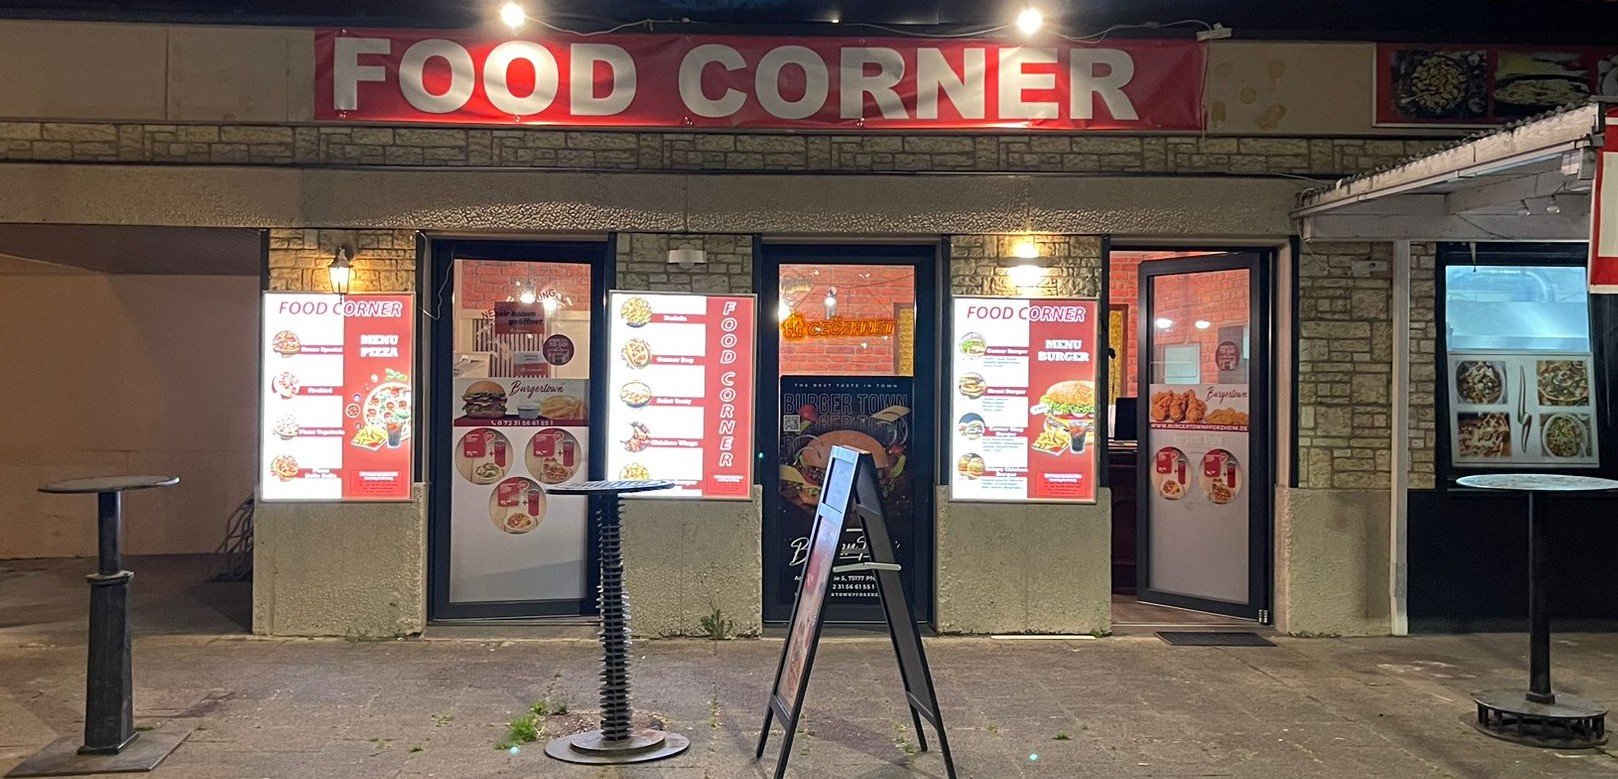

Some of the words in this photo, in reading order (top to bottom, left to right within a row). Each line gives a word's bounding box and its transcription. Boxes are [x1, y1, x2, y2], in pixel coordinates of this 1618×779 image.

[334, 37, 637, 116] FOOD
[678, 43, 1140, 121] CORNER
[279, 301, 328, 315] FOOD
[333, 301, 403, 317] CORNER
[967, 306, 1014, 320] FOOD
[1019, 306, 1086, 322] CORNER
[508, 318, 544, 327] geöffnet
[808, 316, 897, 337] GEÖFFNET
[360, 334, 399, 345] MENU
[719, 301, 738, 365] FOOD
[360, 347, 399, 357] PIZZA
[1045, 339, 1082, 350] MENU
[1038, 351, 1090, 363] BURGER
[509, 380, 565, 399] Burgertown
[1205, 386, 1248, 404] Burgertown
[783, 393, 853, 415] BURGER
[857, 393, 908, 415] TOWN
[718, 371, 737, 467] CORNER
